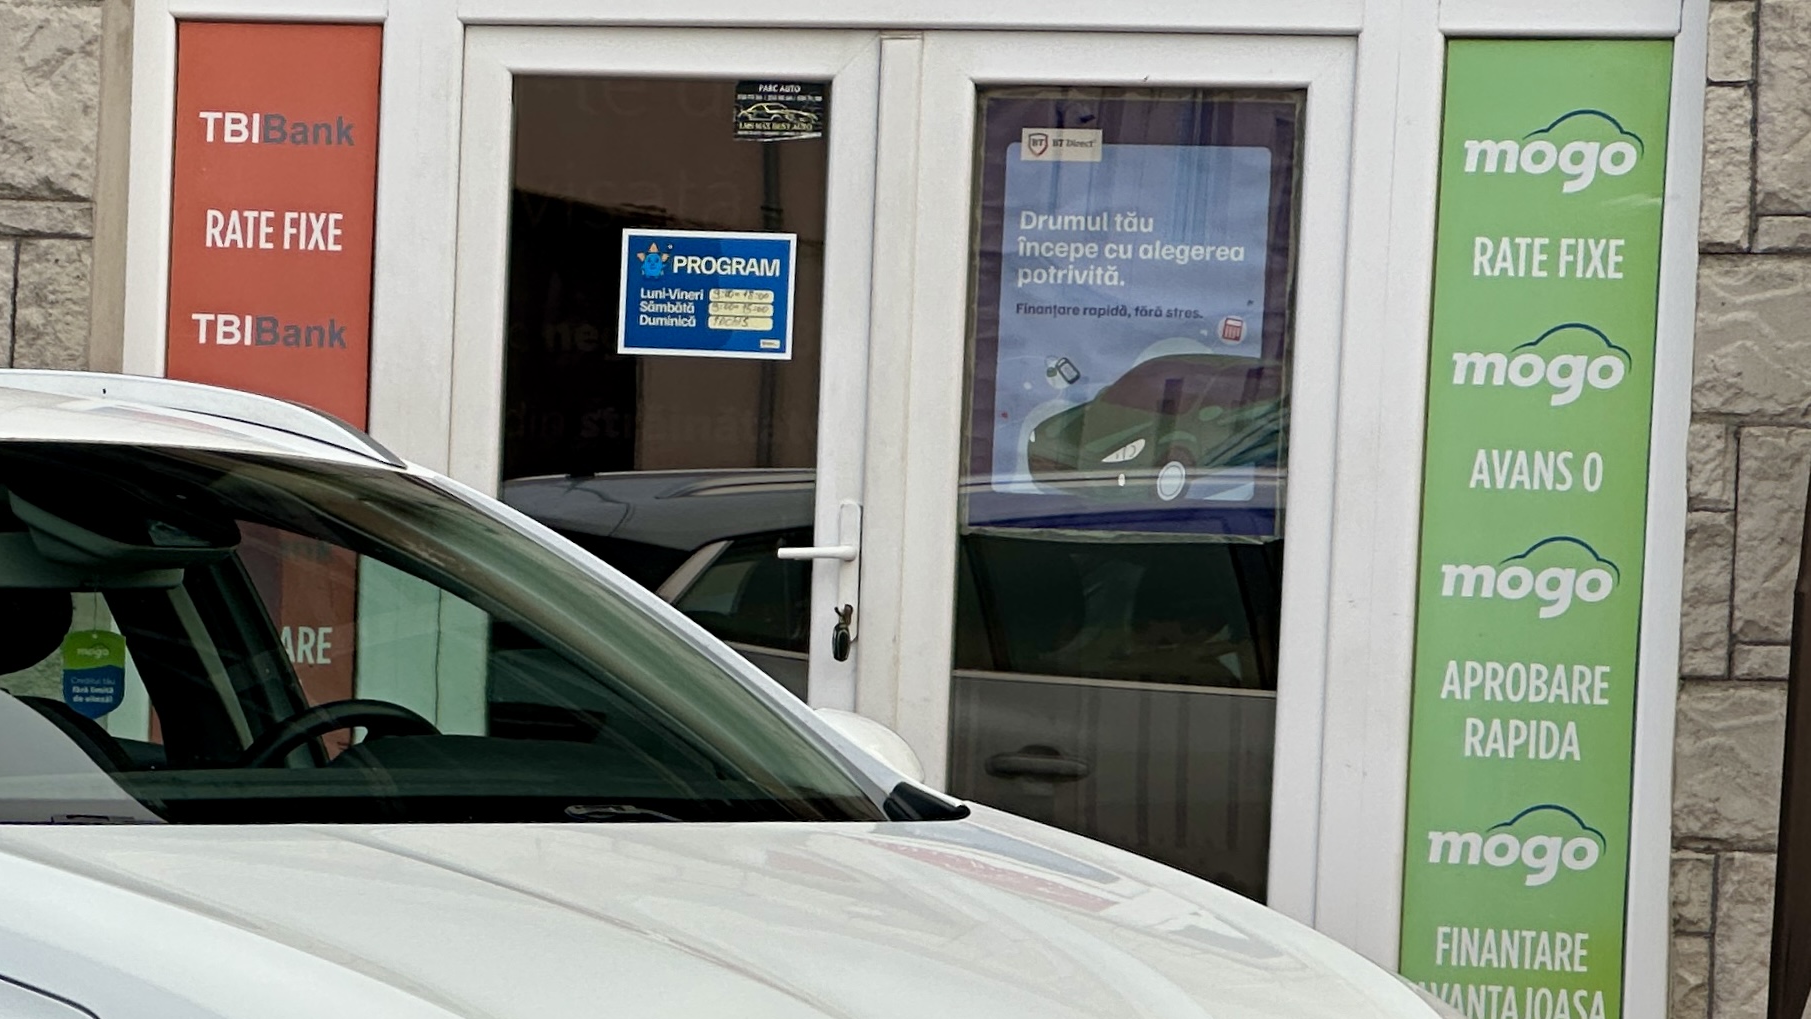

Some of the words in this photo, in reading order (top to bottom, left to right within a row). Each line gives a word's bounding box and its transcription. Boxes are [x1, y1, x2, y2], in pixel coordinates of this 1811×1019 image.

[198, 112, 355, 146] TBIBank
[1464, 139, 1637, 193] mogo
[205, 209, 274, 249] RATE
[283, 211, 343, 252] FIXE
[1020, 211, 1109, 232] Drumul
[1115, 211, 1154, 232] tău
[672, 255, 781, 277] PROGRAM
[1017, 236, 1099, 260] începe
[1104, 243, 1132, 259] cu
[1139, 240, 1245, 264] alegerea
[1472, 237, 1549, 279] RATE
[1558, 238, 1625, 280] FIXE
[640, 287, 704, 300] Luni-Vineri
[1017, 264, 1125, 287] potrivită.
[191, 313, 347, 349] TBIBank
[1452, 351, 1625, 406] mogo
[1469, 450, 1573, 491] AVANS
[1441, 563, 1613, 619] mogo
[281, 626, 333, 665] ARE
[1441, 660, 1611, 705] APROBARE
[1464, 718, 1581, 761] RAPIDA
[1428, 830, 1599, 886] mogo
[1435, 926, 1589, 973] FINANTARE
